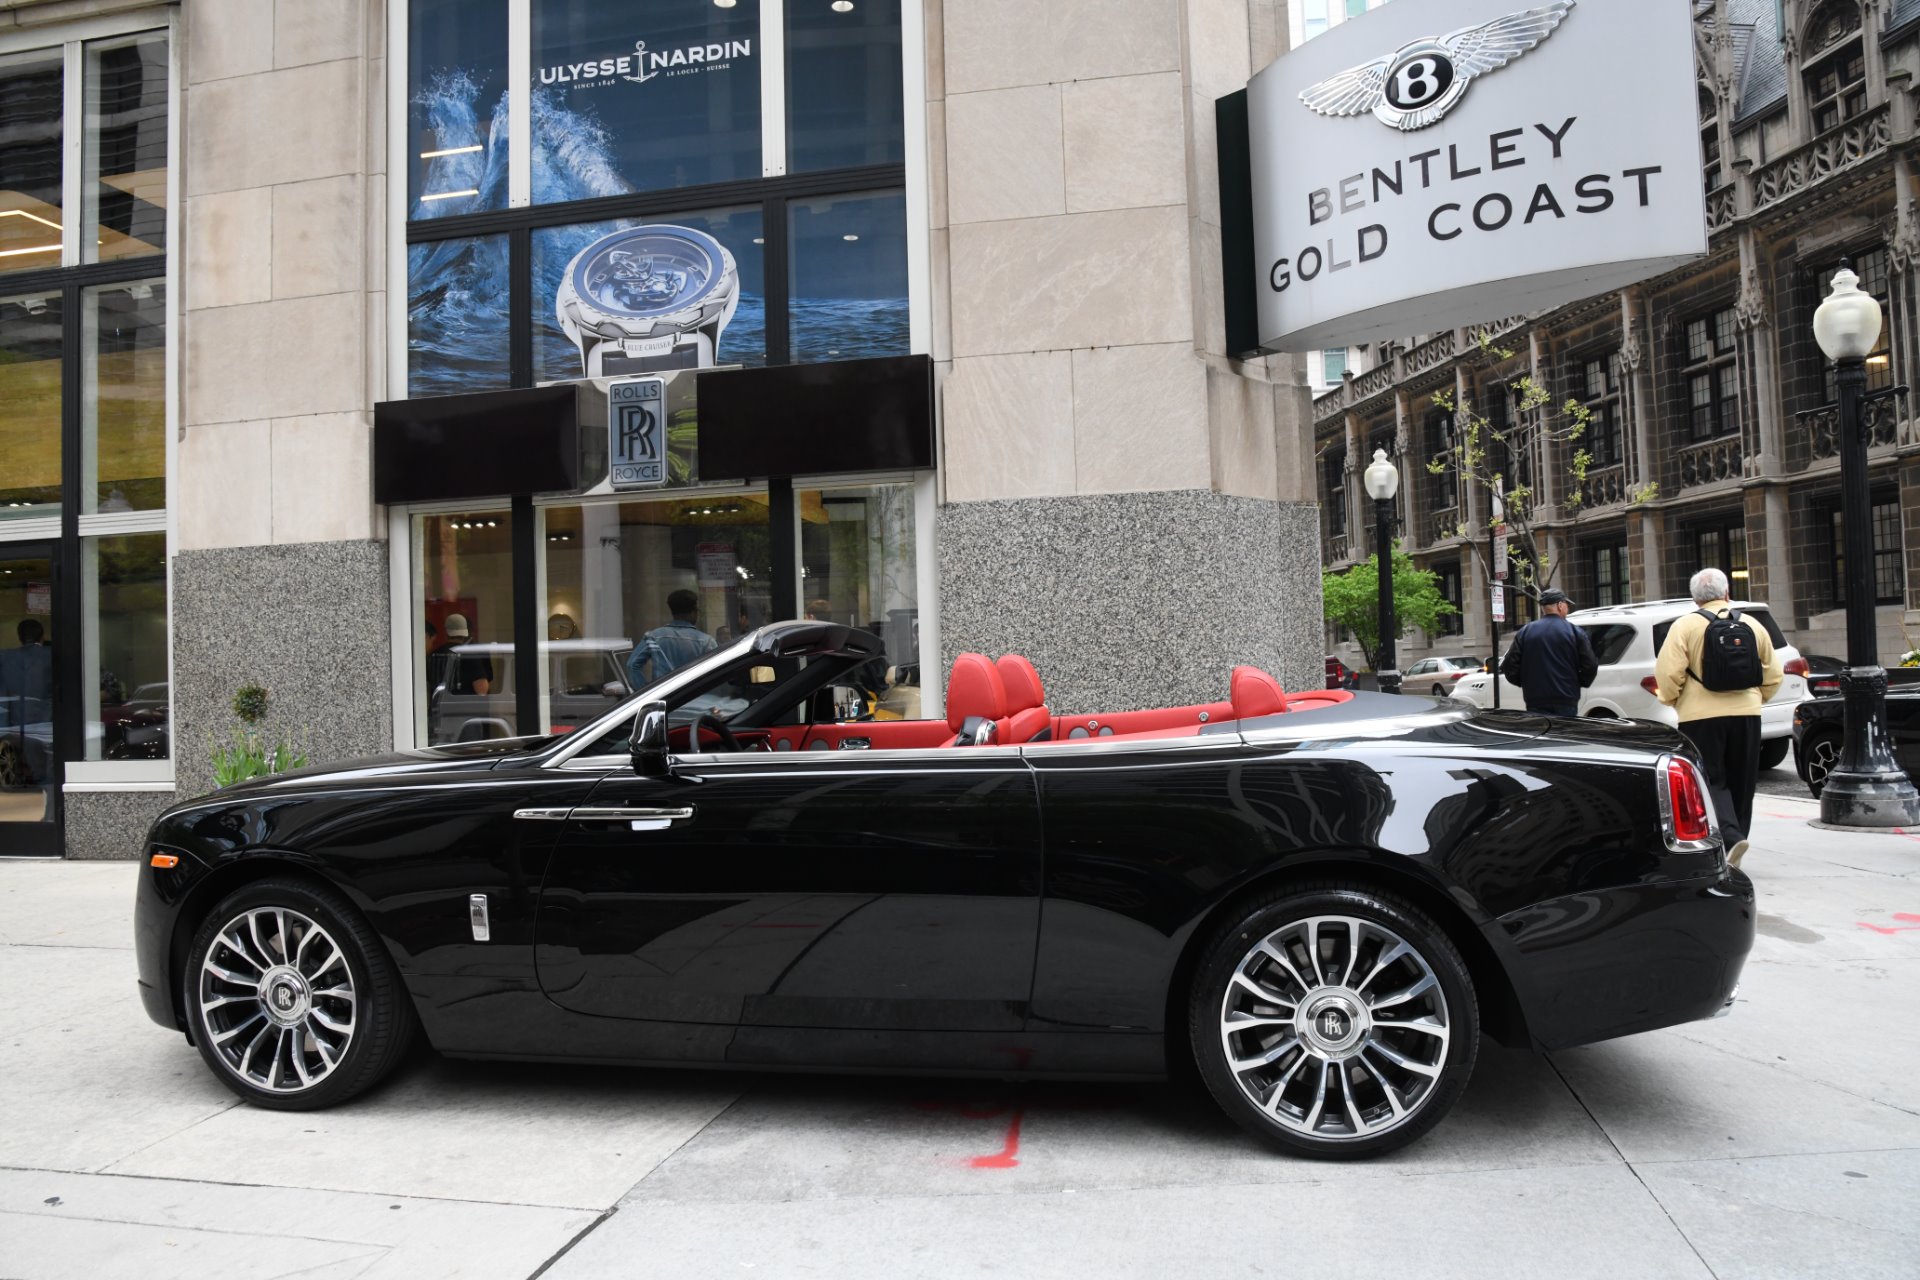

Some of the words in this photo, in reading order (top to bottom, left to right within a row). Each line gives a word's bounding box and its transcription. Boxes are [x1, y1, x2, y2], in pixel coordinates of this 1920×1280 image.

[540, 56, 631, 84] ULYSSE
[650, 39, 751, 70] NARDIN
[676, 68, 699, 76] LOCLE
[706, 63, 730, 71] SUISSE
[573, 82, 595, 90] SINCE
[1395, 58, 1439, 104] B
[1308, 116, 1577, 226] BENTLEY
[1269, 223, 1388, 293] GOLD
[1427, 165, 1662, 241] COAST
[614, 385, 658, 399] ROLLS
[615, 465, 659, 480] ROYCE
